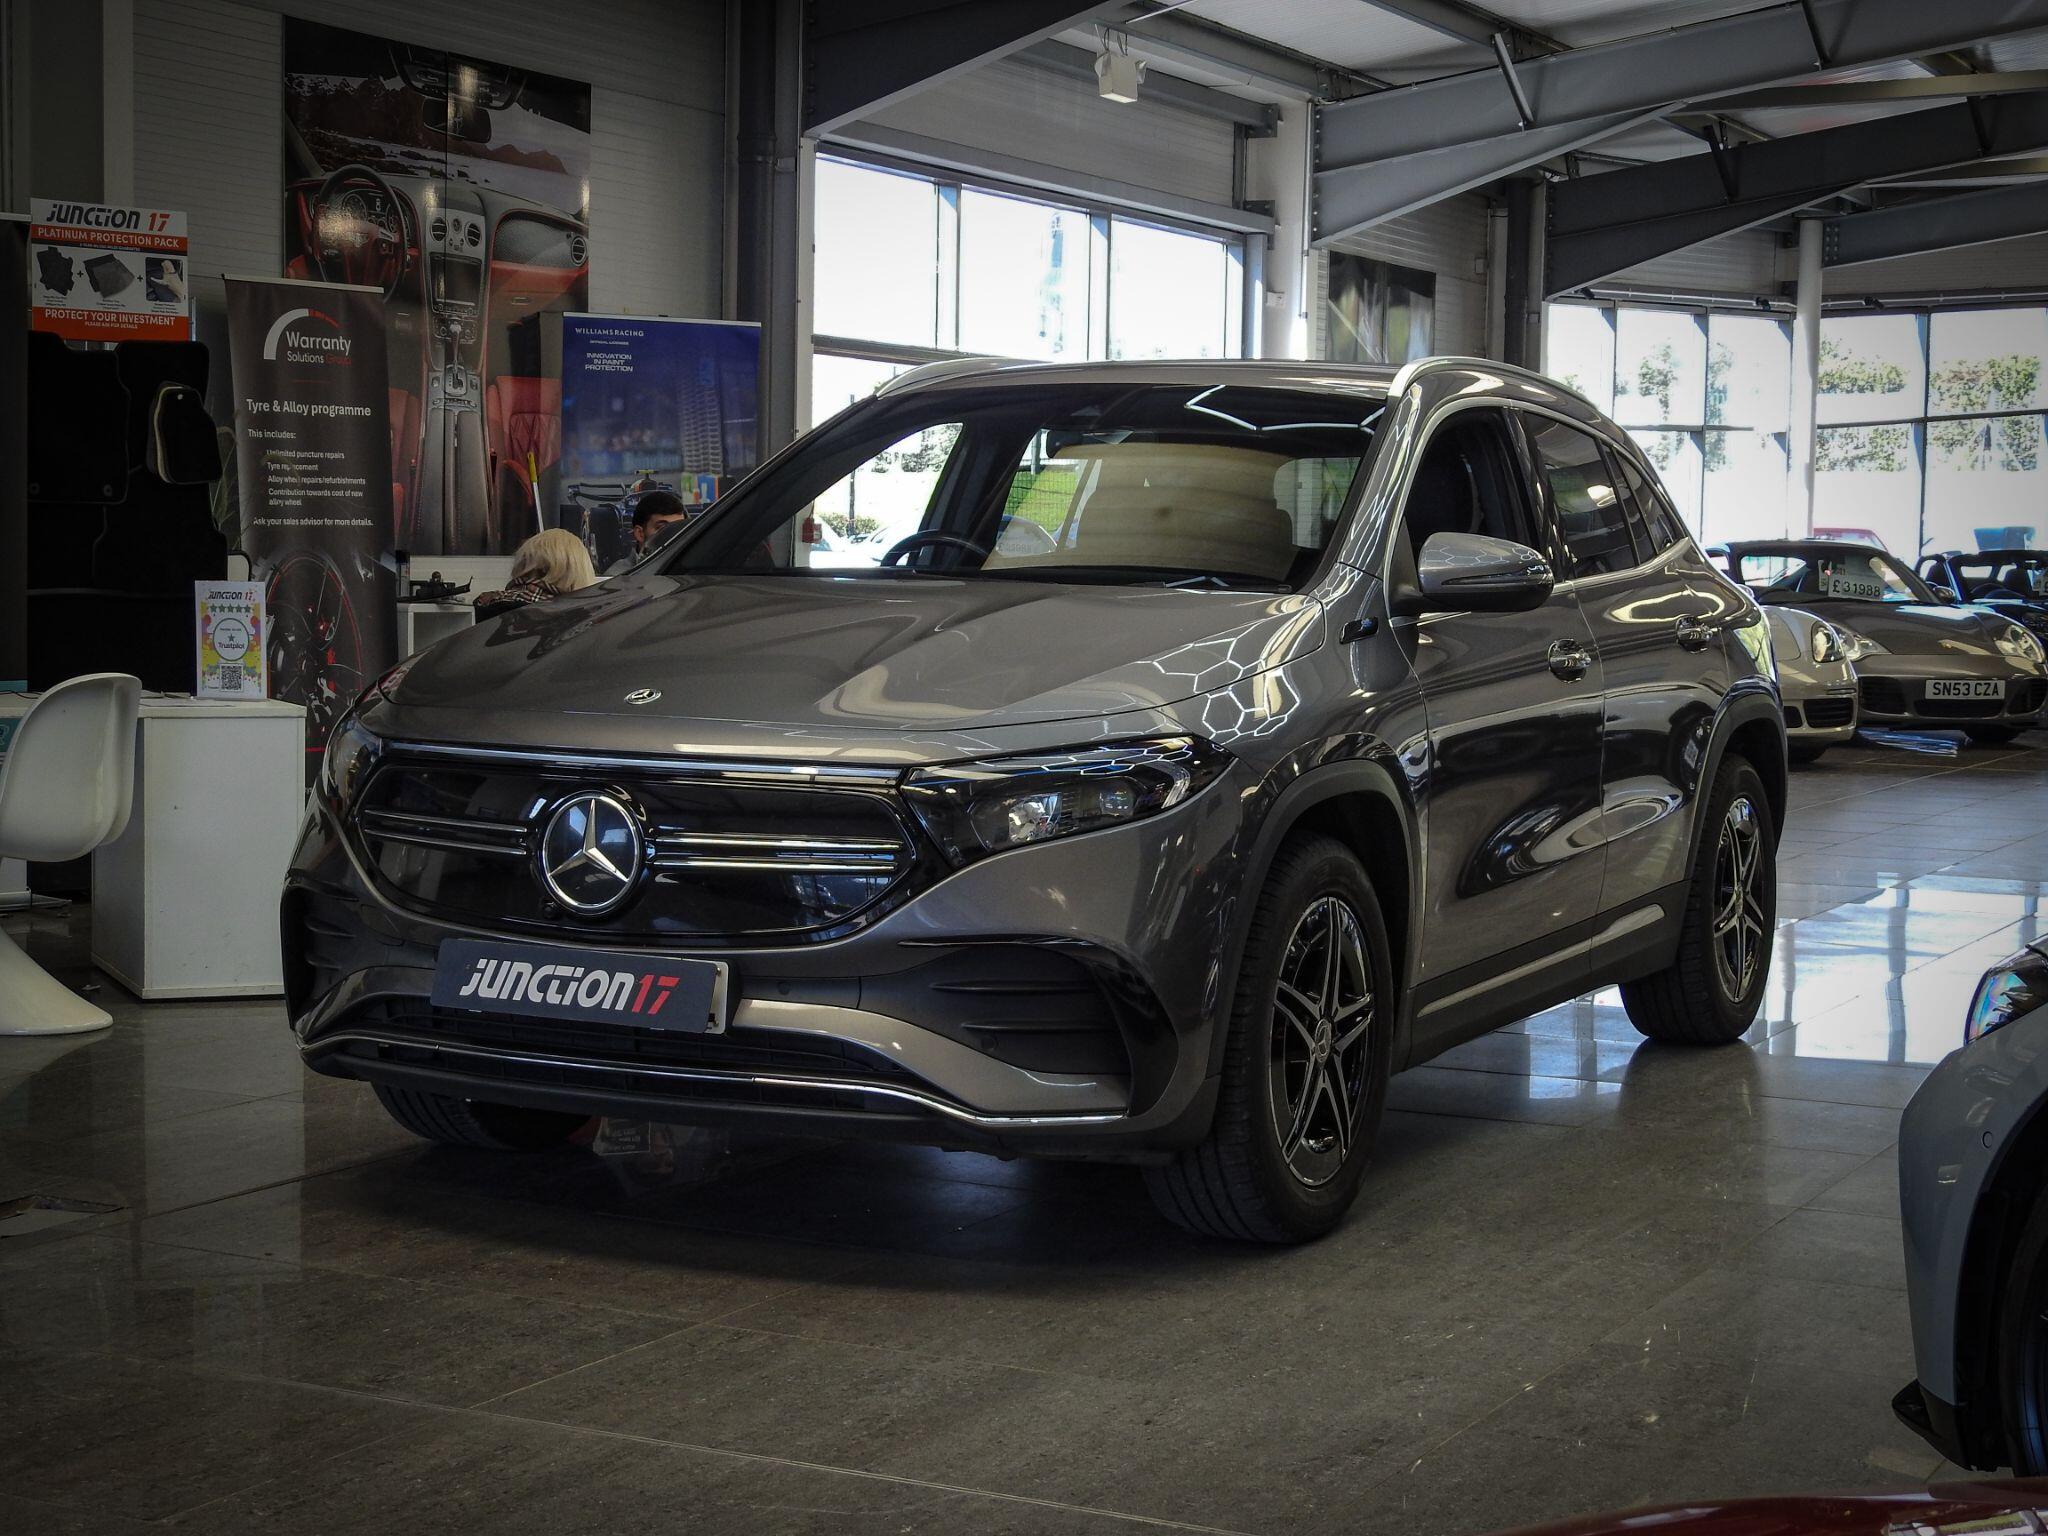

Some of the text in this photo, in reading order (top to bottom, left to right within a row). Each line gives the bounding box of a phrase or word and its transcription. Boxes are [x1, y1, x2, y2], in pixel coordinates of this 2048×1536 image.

[148, 212, 170, 232] 17
[38, 227, 88, 240] PLATINUM
[90, 231, 152, 246] PROTECTION
[154, 236, 180, 248] PACK
[45, 308, 176, 326] PROTECT YOUR INVESTMENT
[286, 331, 351, 356] Warranty
[287, 350, 325, 363] Solutions
[246, 399, 372, 418] Tyre & Alloy programme
[247, 429, 297, 439] This includes:
[296, 451, 324, 459] puncture
[266, 462, 281, 471] Tyre
[268, 475, 283, 485] Alloy
[268, 488, 305, 497] Contribution
[306, 489, 331, 498] towards
[331, 490, 345, 498] cost
[253, 518, 266, 526] Ask
[266, 518, 282, 527] your
[283, 518, 299, 526] sales
[299, 518, 324, 526] advisor
[324, 518, 333, 526] for
[334, 518, 351, 526] more
[1832, 580, 1881, 597] £31988
[218, 642, 245, 650] Trustpilot
[1932, 682, 2000, 697] SN53 CZA
